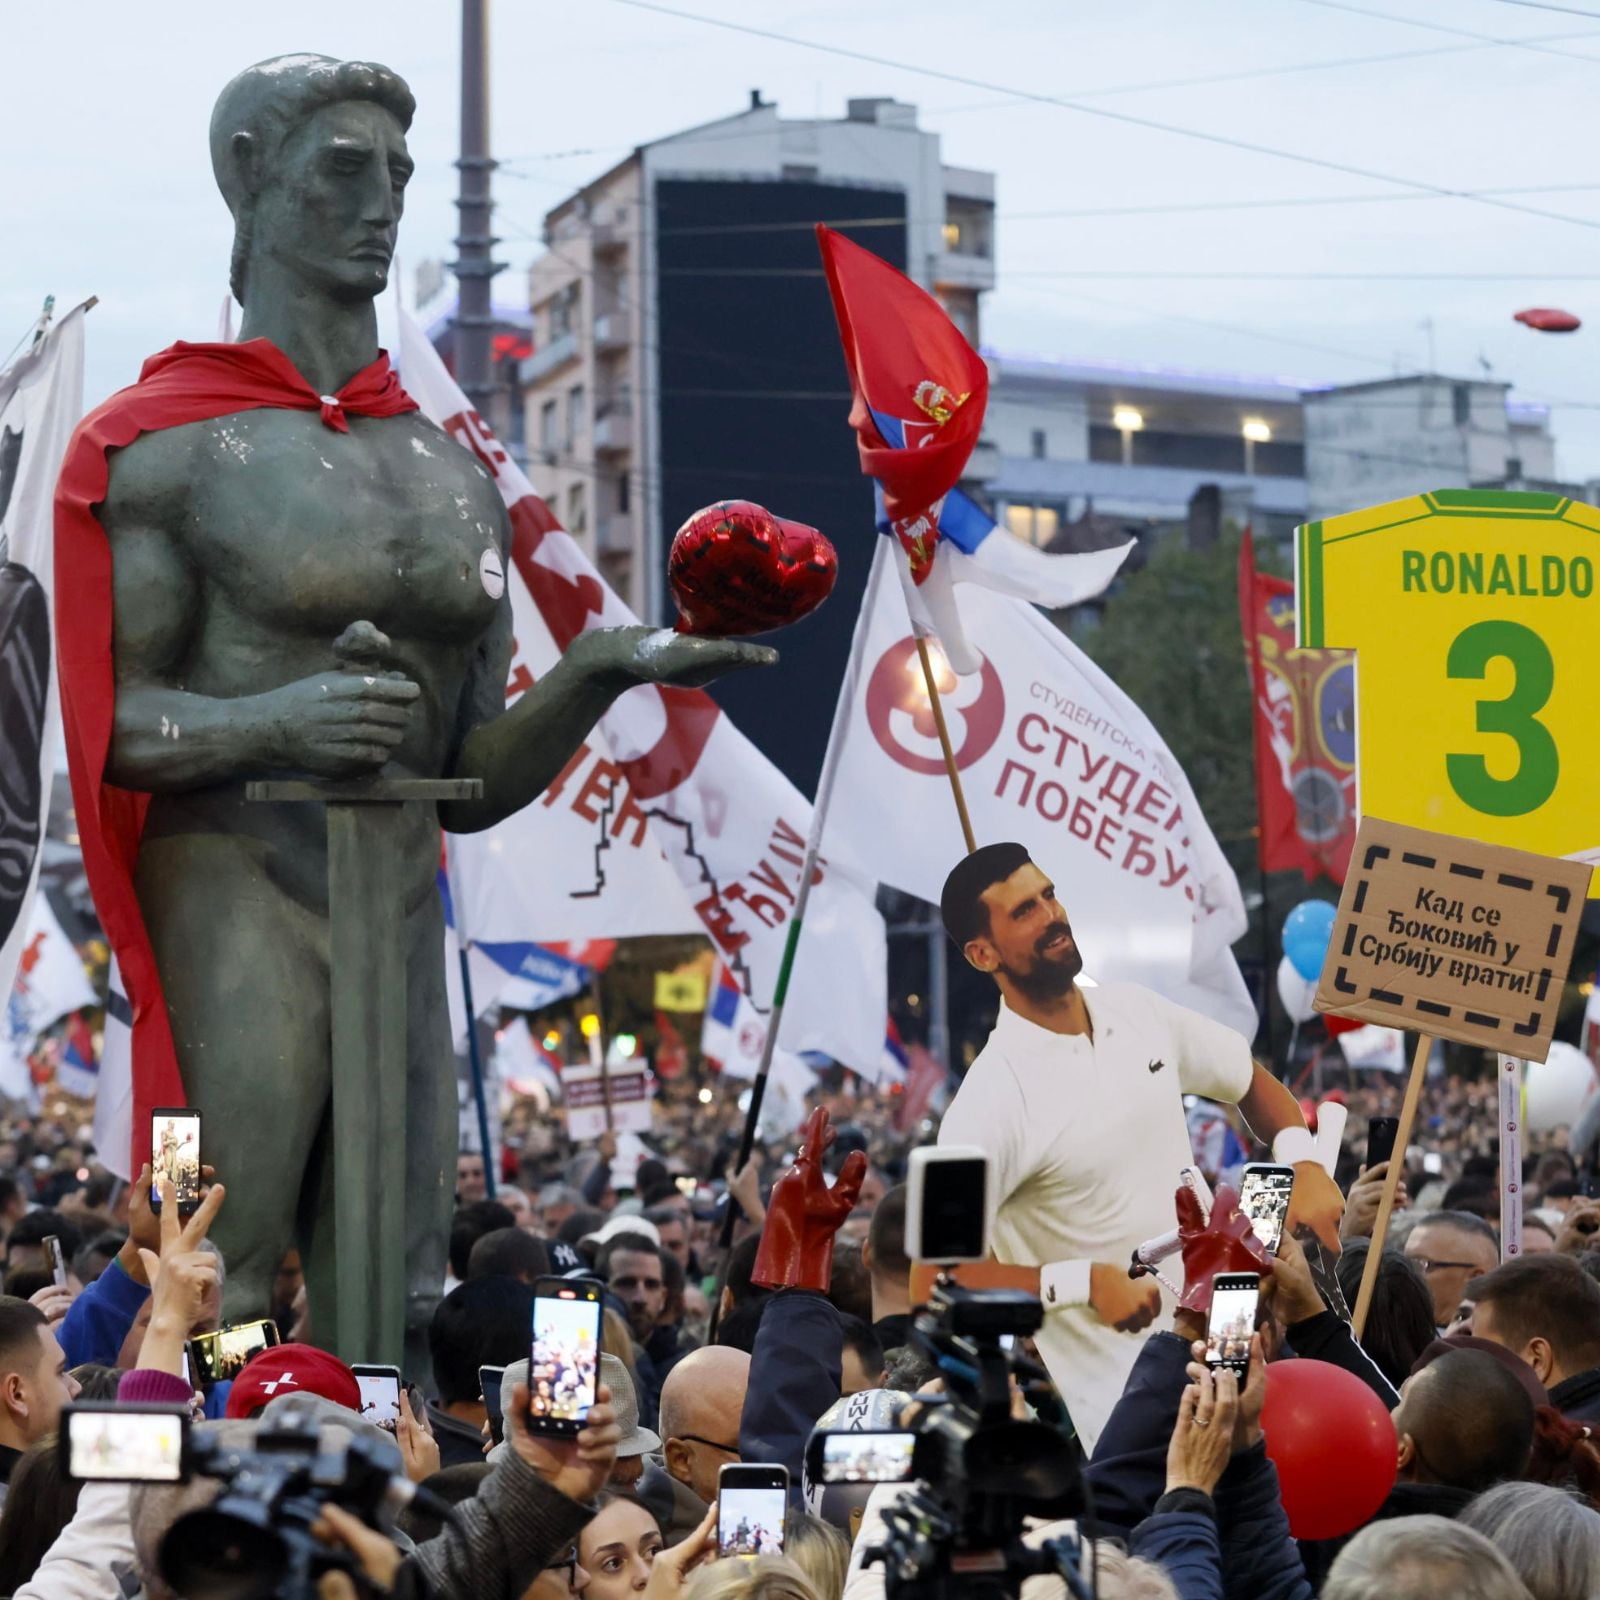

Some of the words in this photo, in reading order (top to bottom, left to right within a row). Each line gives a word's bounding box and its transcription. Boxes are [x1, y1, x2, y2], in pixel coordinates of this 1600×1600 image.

[1402, 550, 1593, 598] RONALDO
[1030, 681, 1146, 762] СТУДЕНТСКА
[1446, 620, 1560, 817] 3
[994, 759, 1197, 902] ПОБЕЂУ
[1415, 887, 1464, 923] Кад
[1471, 905, 1502, 926] се
[1359, 934, 1443, 977] Србију
[1448, 959, 1535, 995] врати!
[1387, 909, 1497, 957] Ђоковић
[1502, 941, 1520, 967] у
